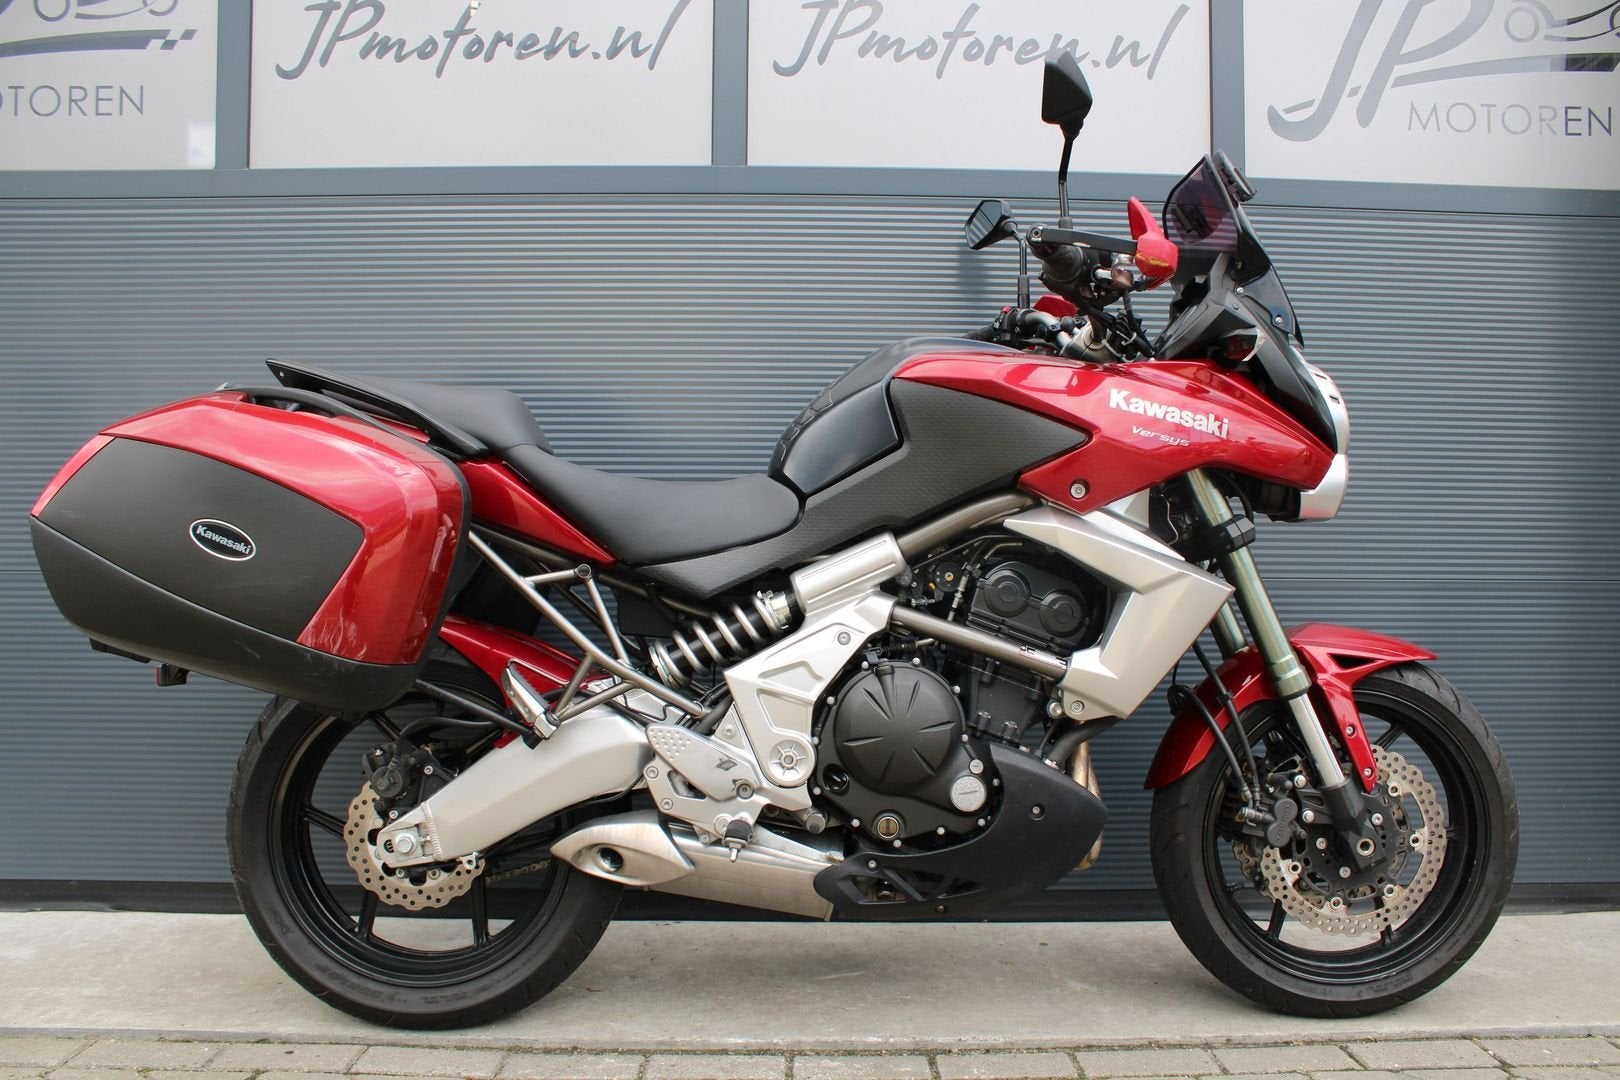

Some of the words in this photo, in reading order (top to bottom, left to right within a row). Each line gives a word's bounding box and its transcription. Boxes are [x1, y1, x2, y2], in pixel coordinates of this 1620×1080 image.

[276, 0, 692, 80] JPmotoren.nl
[773, 0, 1190, 80] JPmotoren.nl
[0, 84, 145, 117] TOREN
[1407, 101, 1613, 138] MOTOREN
[1109, 387, 1230, 439] Kawasaki
[196, 525, 251, 555] Kawasaki
